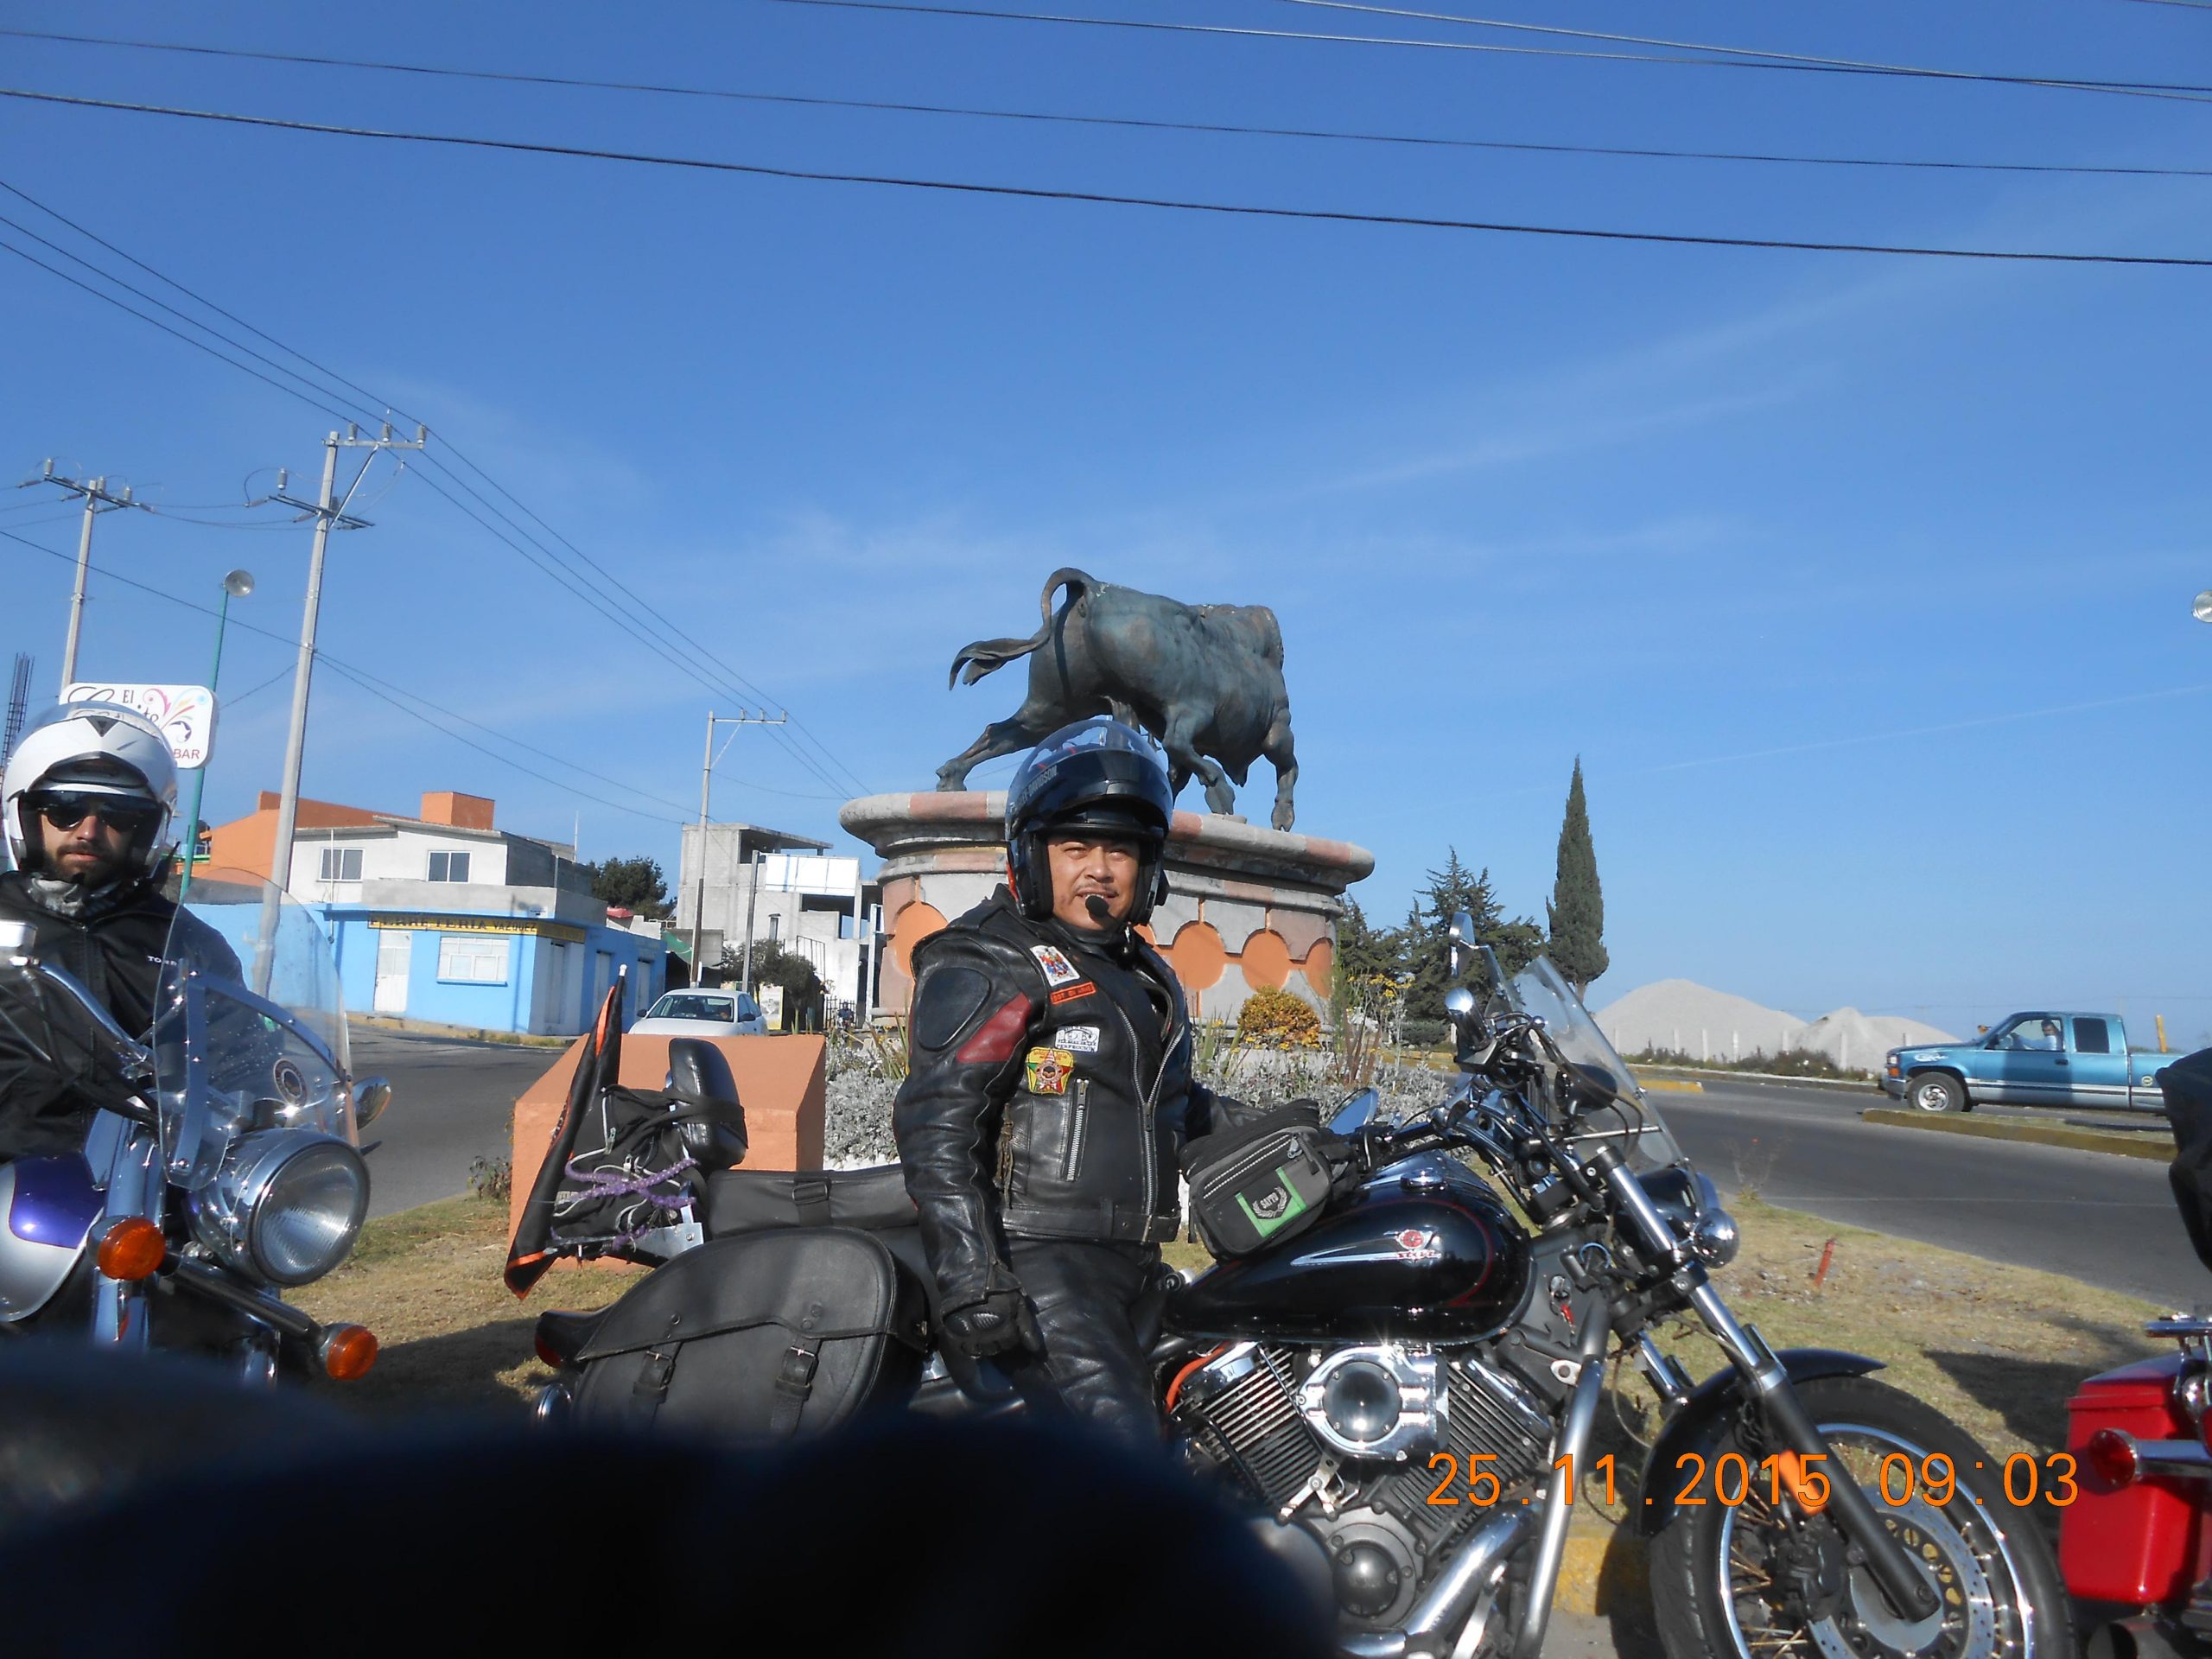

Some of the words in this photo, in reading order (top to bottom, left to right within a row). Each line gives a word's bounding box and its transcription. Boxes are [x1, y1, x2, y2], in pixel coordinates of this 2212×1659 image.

[123, 690, 134, 703] El
[174, 749, 200, 760] BAR
[493, 920, 537, 932] VAZQUEZ
